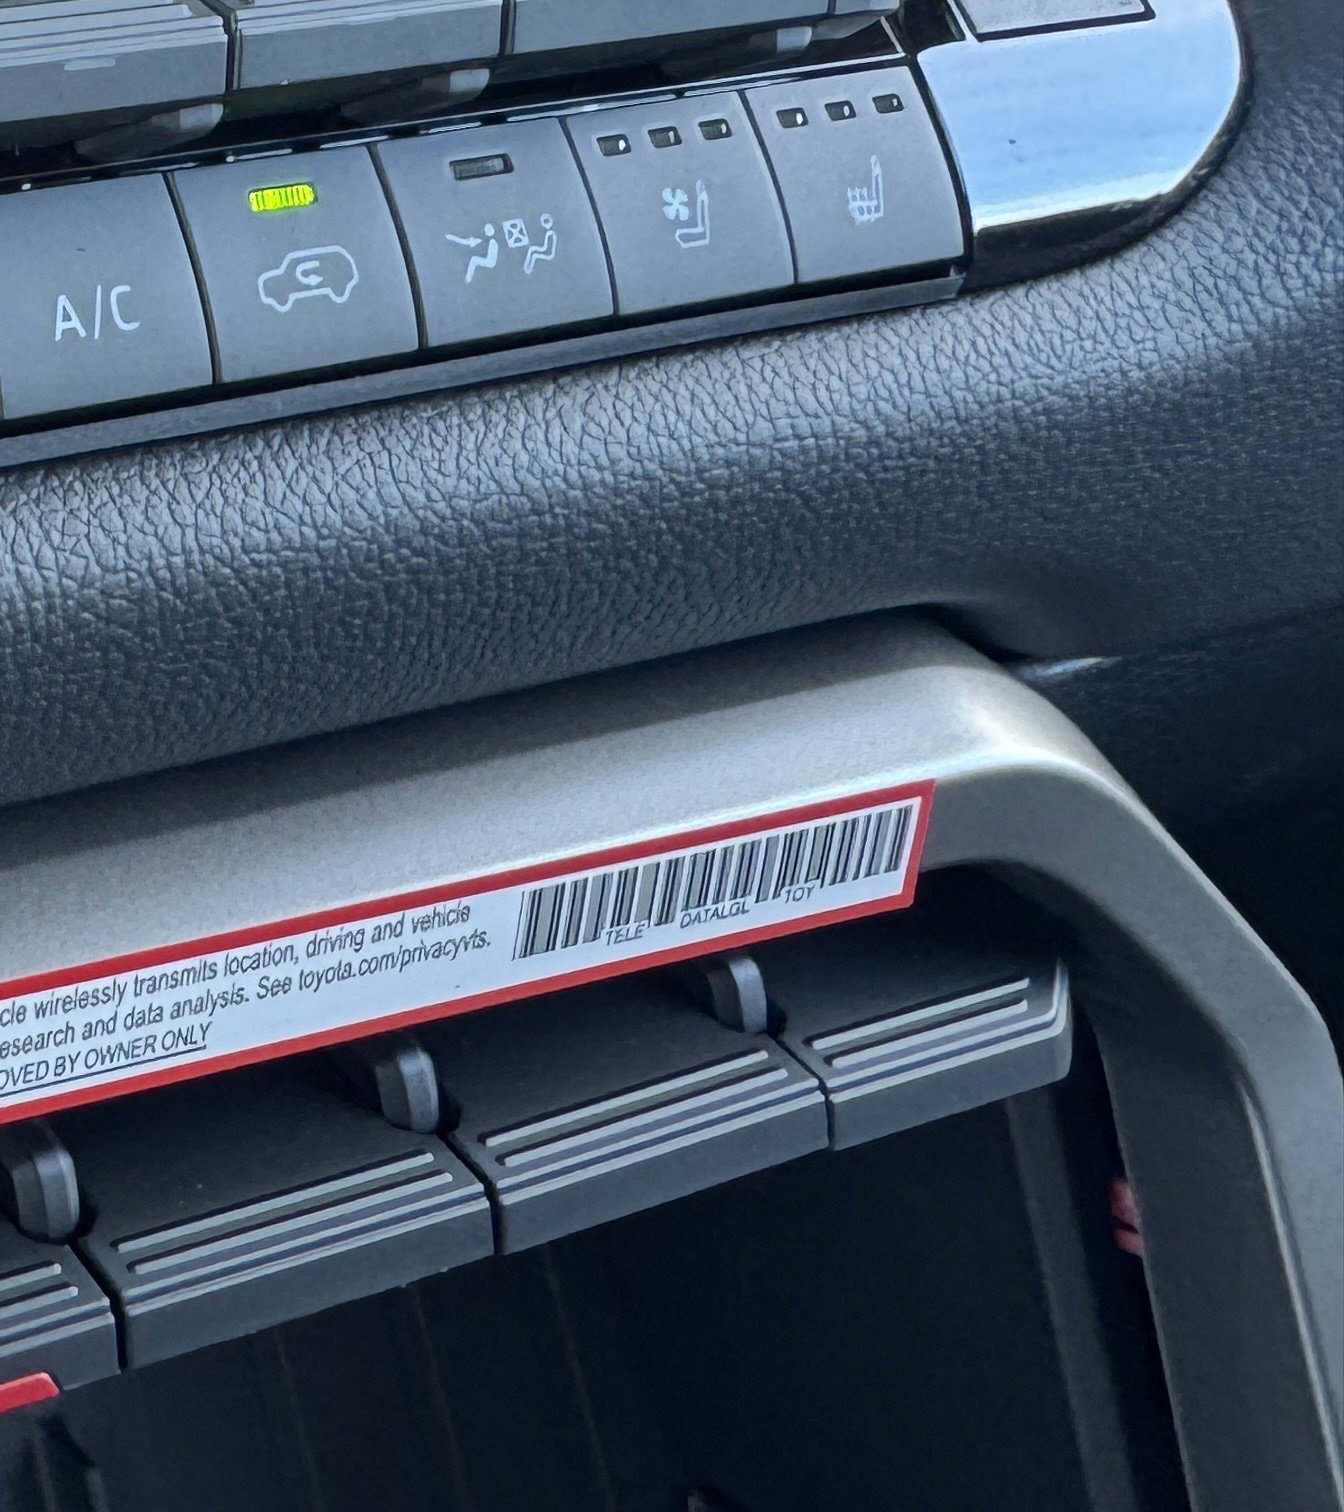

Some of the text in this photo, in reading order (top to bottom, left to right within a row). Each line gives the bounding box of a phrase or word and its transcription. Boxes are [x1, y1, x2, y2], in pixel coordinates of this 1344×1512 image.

[55, 284, 140, 342] A/C
[34, 977, 128, 1020] wirelessly
[133, 958, 217, 998] transmits
[224, 941, 299, 976] location,
[306, 925, 365, 958] driving
[370, 912, 405, 944] and
[410, 900, 472, 933] vehicle
[82, 1008, 118, 1040] and
[123, 1000, 163, 1031] data
[169, 982, 250, 1018] analysis.
[256, 975, 292, 1000] See
[54, 1050, 81, 1076] BY
[84, 1035, 156, 1070] OWNER
[162, 1020, 212, 1052] ONLY
